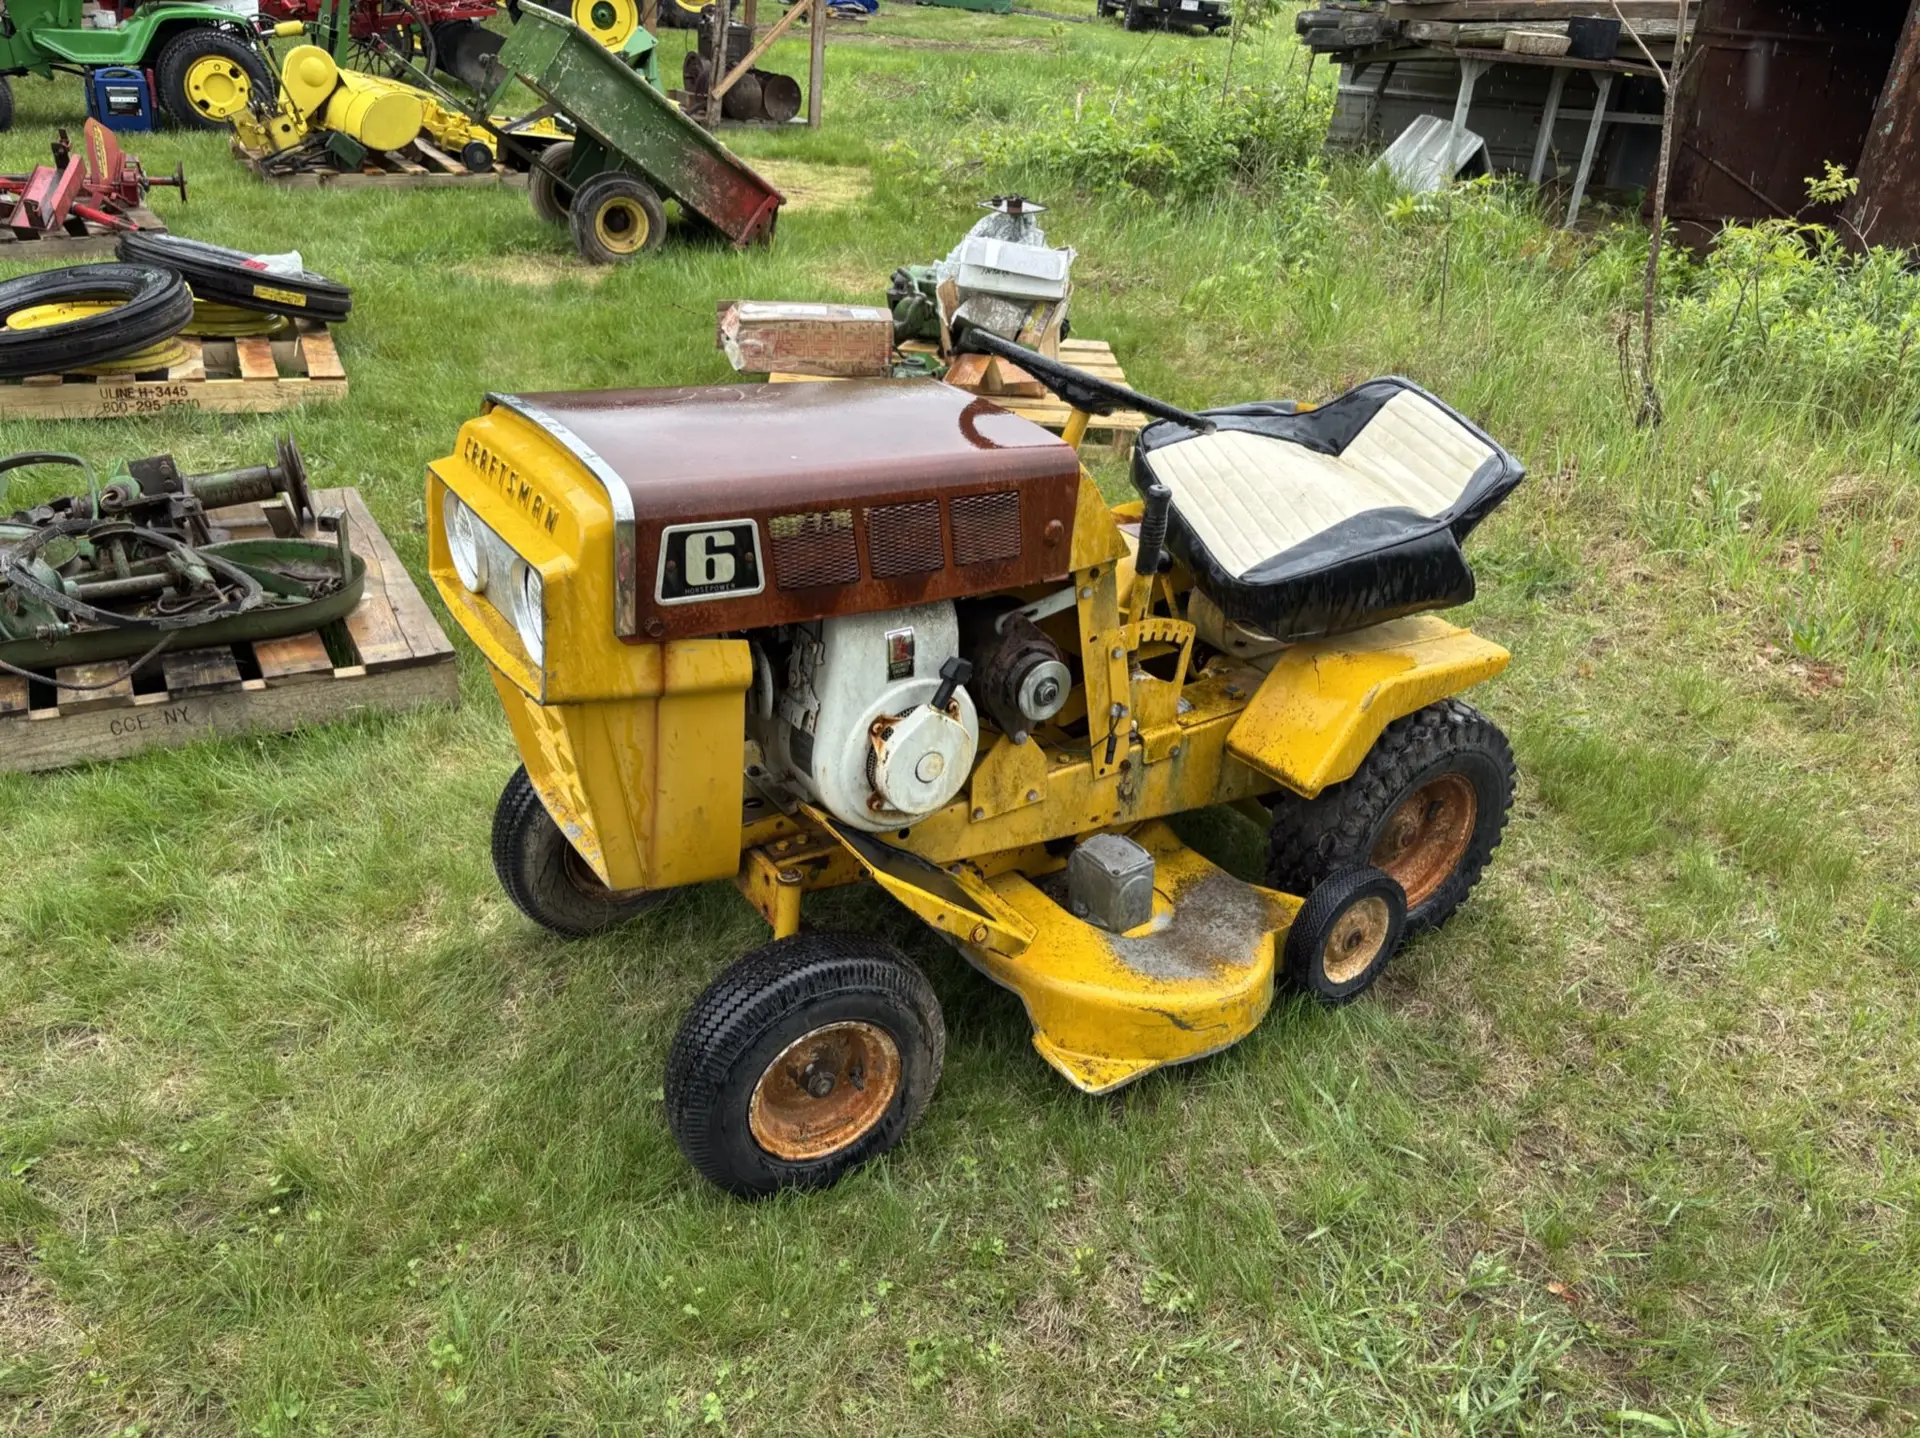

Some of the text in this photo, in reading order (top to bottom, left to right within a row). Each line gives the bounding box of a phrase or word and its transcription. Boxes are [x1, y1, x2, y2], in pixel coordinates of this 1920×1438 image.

[100, 387, 135, 399] ULINE
[464, 437, 559, 535] CRAFTSMAN
[685, 530, 736, 587] 6
[684, 582, 736, 595] HORSEPOWER
